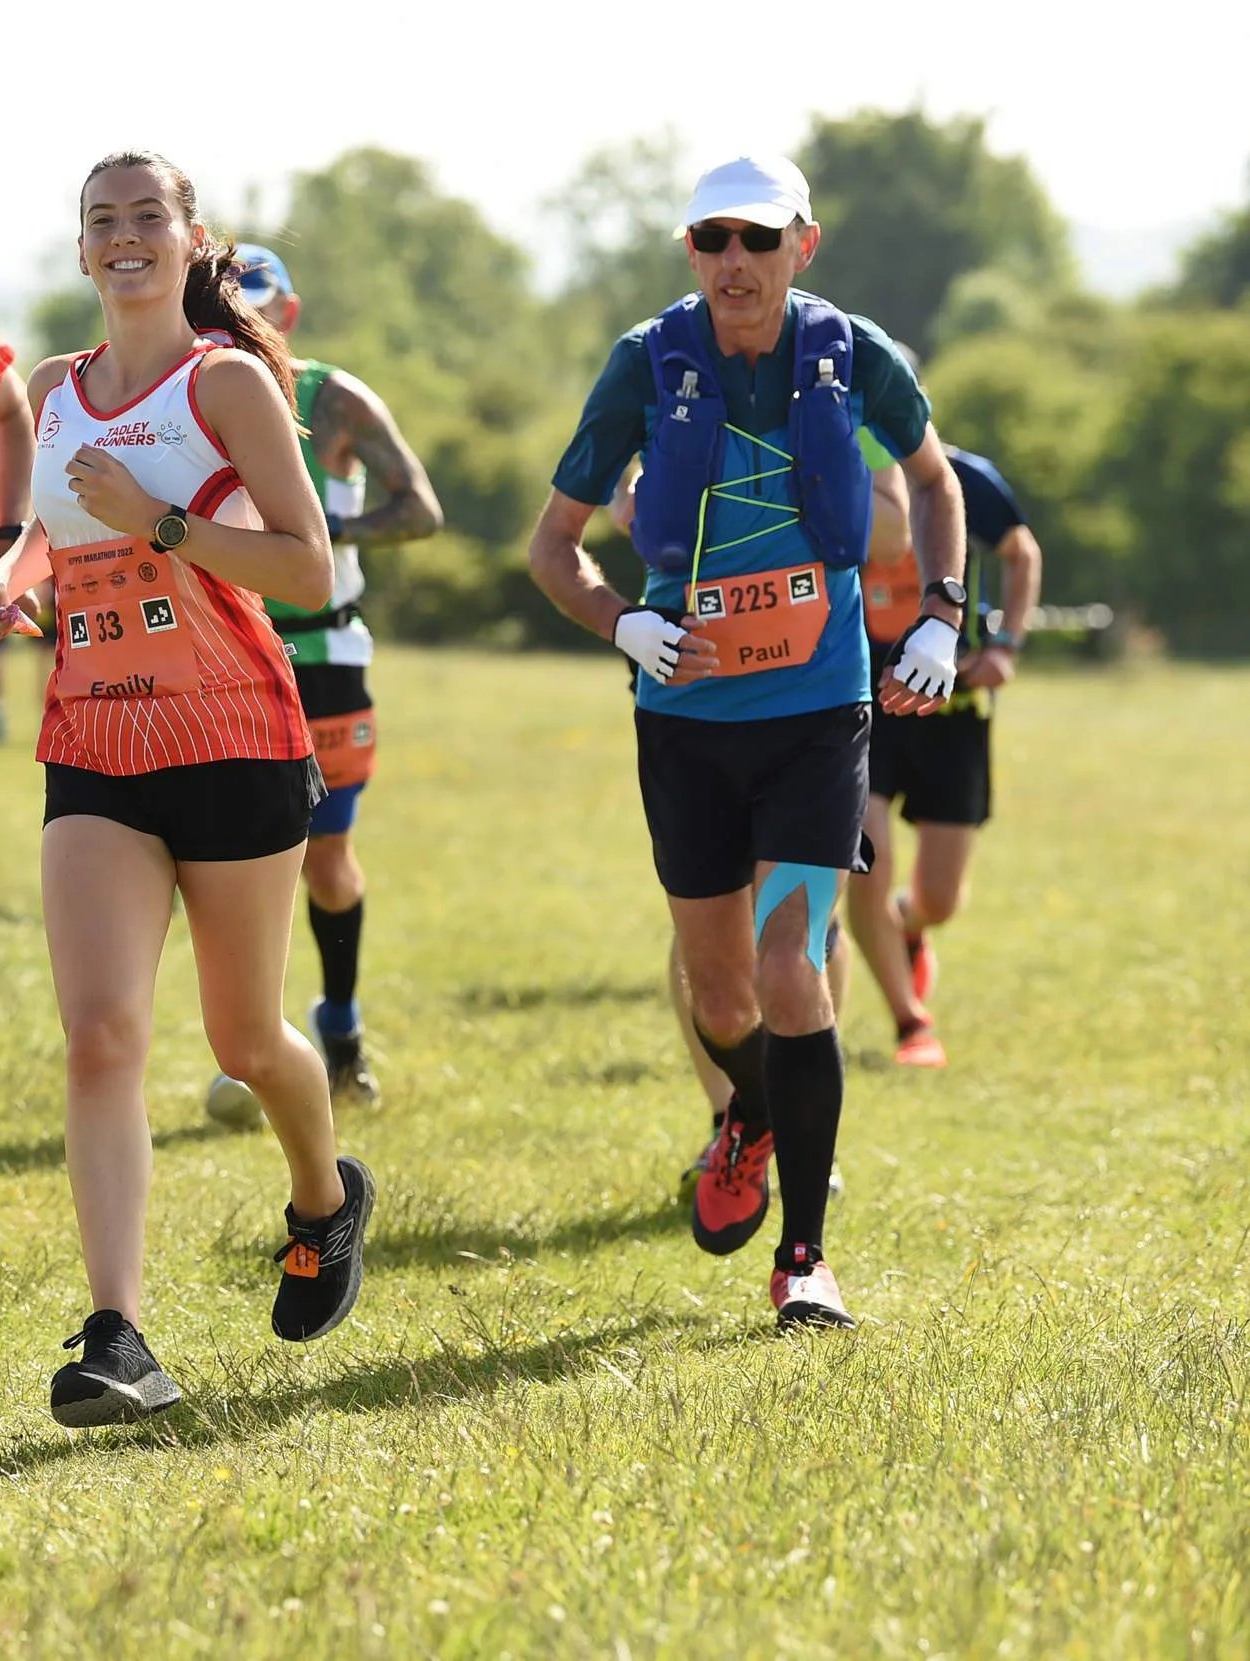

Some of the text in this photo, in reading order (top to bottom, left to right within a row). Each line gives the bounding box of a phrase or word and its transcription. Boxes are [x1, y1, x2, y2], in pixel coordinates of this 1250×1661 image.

[94, 434, 156, 447] RUNNERS
[106, 421, 150, 438] TADLEY
[84, 549, 116, 563] MARATHON
[117, 547, 134, 558] 2022
[730, 581, 777, 615] 225
[96, 611, 123, 642] 33
[739, 639, 790, 664] Paul
[91, 674, 154, 697] Emily
